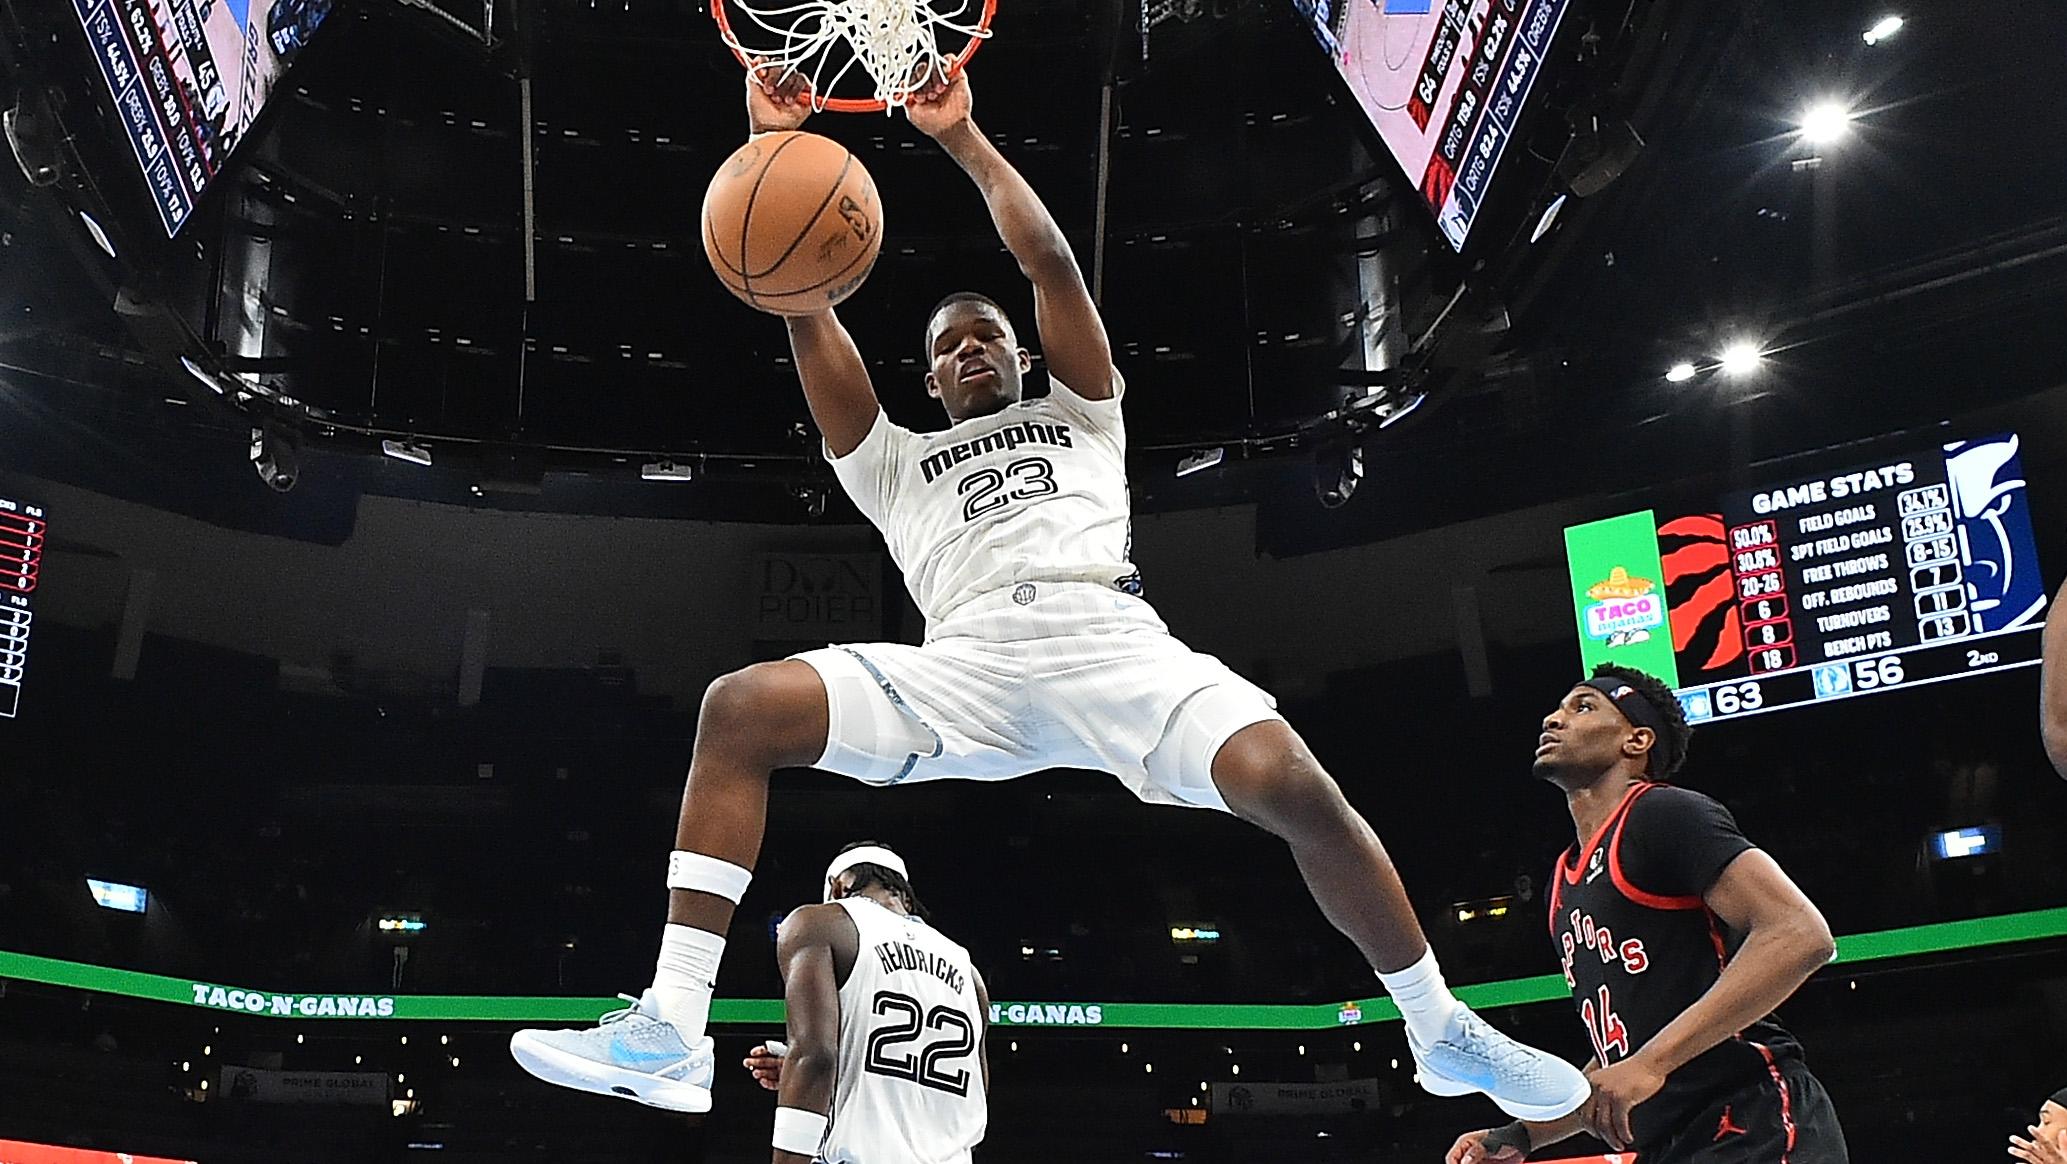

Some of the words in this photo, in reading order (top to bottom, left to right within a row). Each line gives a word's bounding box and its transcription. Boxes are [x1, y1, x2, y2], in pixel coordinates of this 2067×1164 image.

[198, 60, 215, 89] 45
[1419, 73, 1437, 104] 64
[1444, 123, 1463, 159] ORTG
[1466, 155, 1486, 192] ORTG
[920, 421, 1073, 484] memphis
[957, 456, 1059, 523] 23
[1752, 481, 1828, 514] GAME
[1830, 462, 1915, 498] STATS
[1903, 489, 1941, 513] 34.1%
[1799, 513, 1834, 534] FIELD
[1834, 504, 1876, 525] GOALS
[1734, 524, 1773, 549] 50.0%
[1791, 542, 1814, 561] 3PT
[1816, 535, 1850, 556] FIELD
[1851, 526, 1893, 549] GOALS
[1913, 538, 1950, 562] 8-15
[1803, 565, 1834, 584] FREE
[1835, 554, 1889, 580] THROWS
[1929, 568, 1941, 586] 7
[1741, 573, 1780, 596] 20-26
[1802, 592, 1831, 610] OFF.
[1831, 578, 1898, 604] REBOUNDS
[1595, 599, 1651, 621] TACO
[1758, 600, 1771, 619] 6
[1931, 593, 1948, 611] 11
[1817, 605, 1891, 633] TURNOVERS
[1934, 618, 1955, 637] 13
[1762, 625, 1775, 644] 8
[1824, 635, 1866, 658] BENCH
[1867, 632, 1892, 650] PTS
[1762, 649, 1783, 670] 18
[1855, 655, 1905, 689] 56
[1714, 681, 1763, 715] 63
[1562, 908, 1649, 987] PTORS
[874, 941, 965, 995] HENDRICKS
[192, 983, 394, 1017] TACO-N-GANAS
[1581, 984, 1629, 1068] 14
[864, 990, 975, 1098] 22
